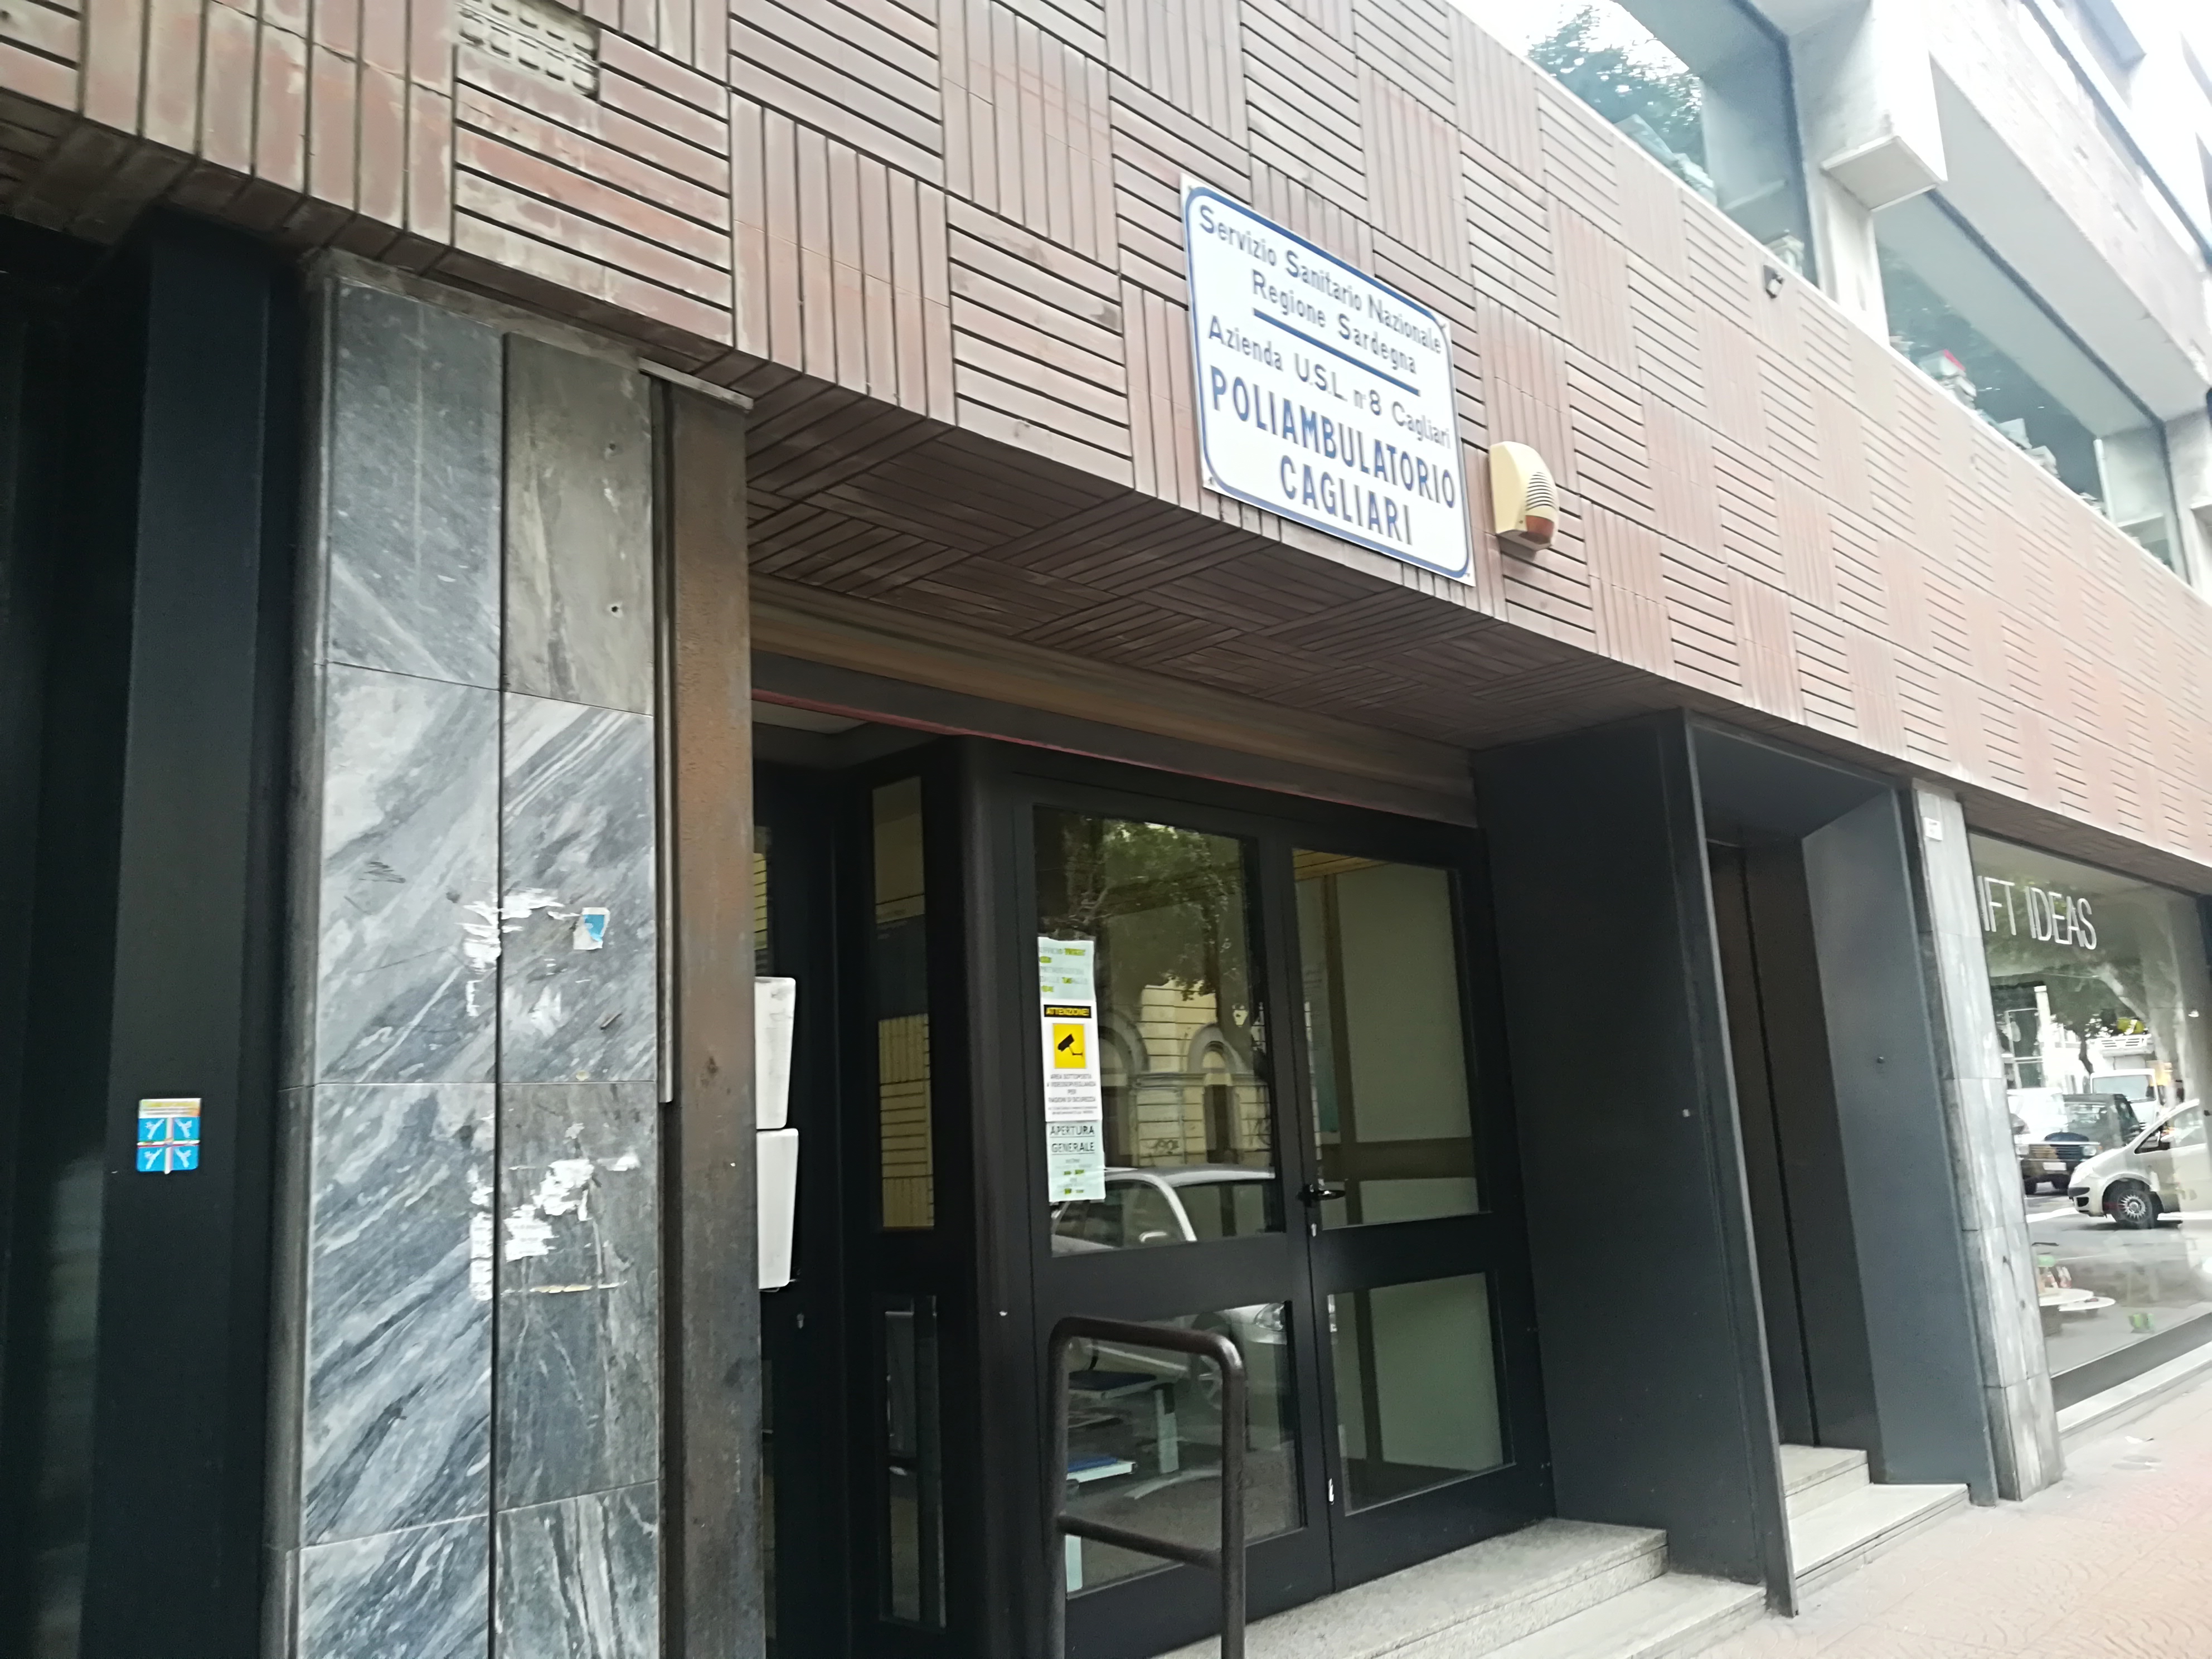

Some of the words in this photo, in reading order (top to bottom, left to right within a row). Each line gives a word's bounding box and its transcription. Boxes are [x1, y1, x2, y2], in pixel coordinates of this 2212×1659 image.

[1199, 204, 1277, 268] Servizio
[1284, 249, 1362, 312] Sanitario
[1368, 294, 1442, 355] Nazionale
[1251, 269, 1326, 328] Regione
[1338, 313, 1417, 375] Sardegna
[1208, 314, 1284, 371] Azienda
[1392, 401, 1451, 449] Cagliari
[1209, 365, 1456, 508] POLIAMBULATORIO
[1280, 455, 1413, 545] CAGLIARI
[2024, 885, 2097, 950] IDEAS
[1050, 1126, 1095, 1135] APERTURA
[1051, 1142, 1095, 1152] GENERALE
